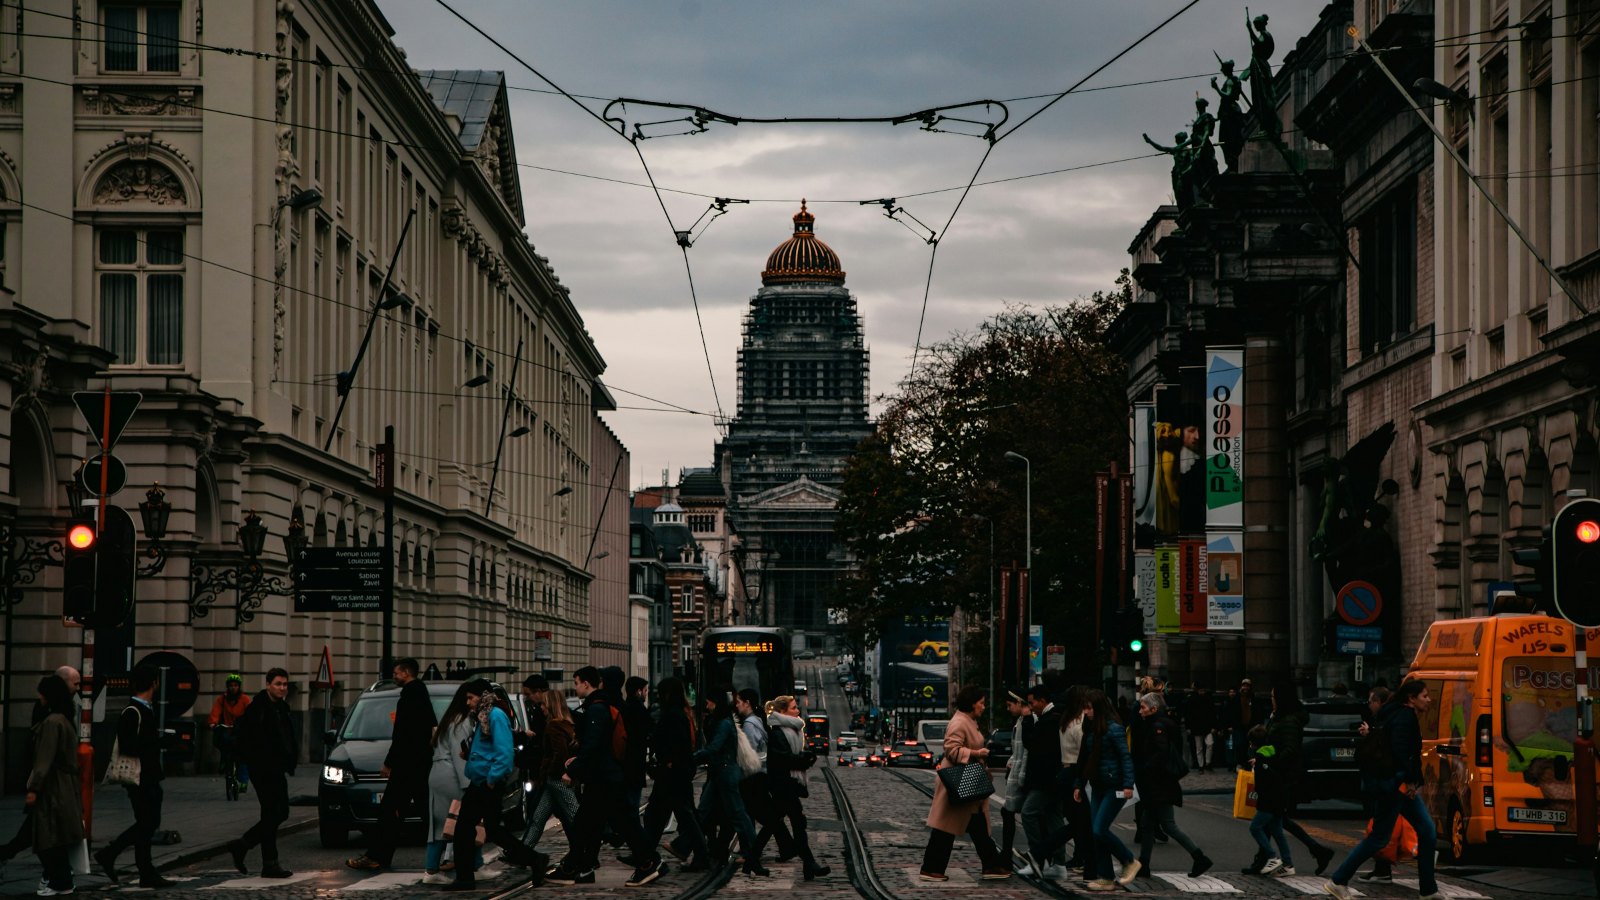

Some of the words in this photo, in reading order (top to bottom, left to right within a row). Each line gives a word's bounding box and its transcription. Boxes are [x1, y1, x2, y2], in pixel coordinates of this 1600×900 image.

[1210, 385, 1231, 493] Picasso
[1160, 552, 1169, 562] in
[1185, 545, 1194, 591] masters
[1160, 563, 1170, 588] walk
[1198, 546, 1207, 593] museum
[1184, 593, 1194, 613] old
[1502, 622, 1565, 645] WAFELS
[1522, 639, 1548, 655] IJS
